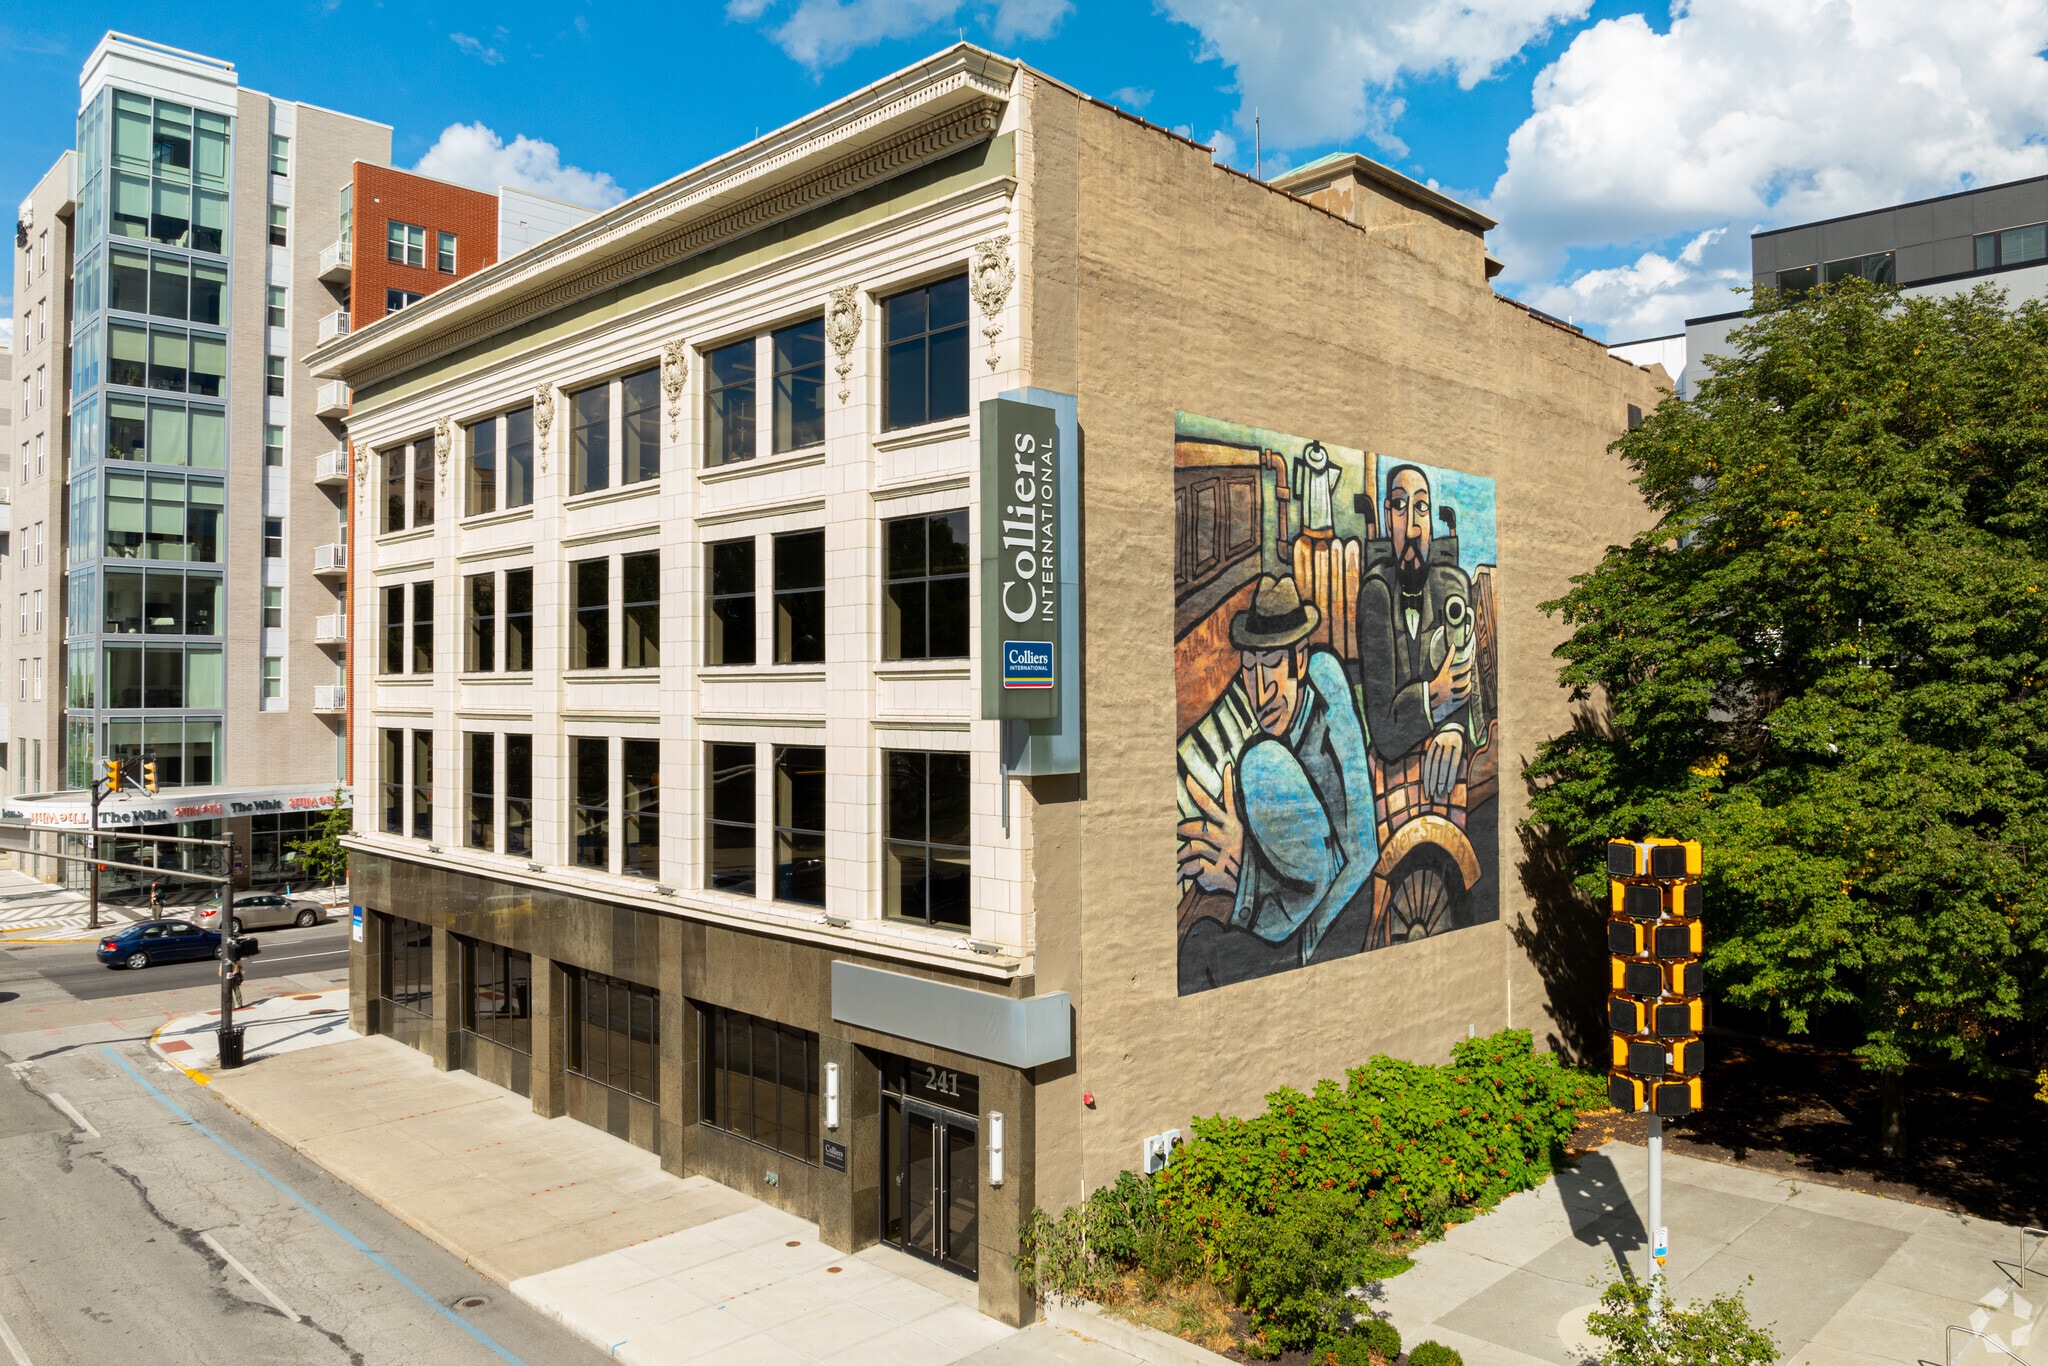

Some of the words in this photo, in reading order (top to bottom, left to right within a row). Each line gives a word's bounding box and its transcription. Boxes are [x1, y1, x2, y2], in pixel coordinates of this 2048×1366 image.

[1002, 433, 1037, 623] Colliers
[1041, 438, 1054, 622] INTERNATIONAL
[1009, 649, 1049, 664] Colliers
[230, 801, 253, 813] The
[253, 799, 282, 811] Whit
[60, 812, 89, 825] The
[99, 811, 131, 824] The
[131, 809, 168, 822] Whit
[925, 1066, 960, 1097] 241
